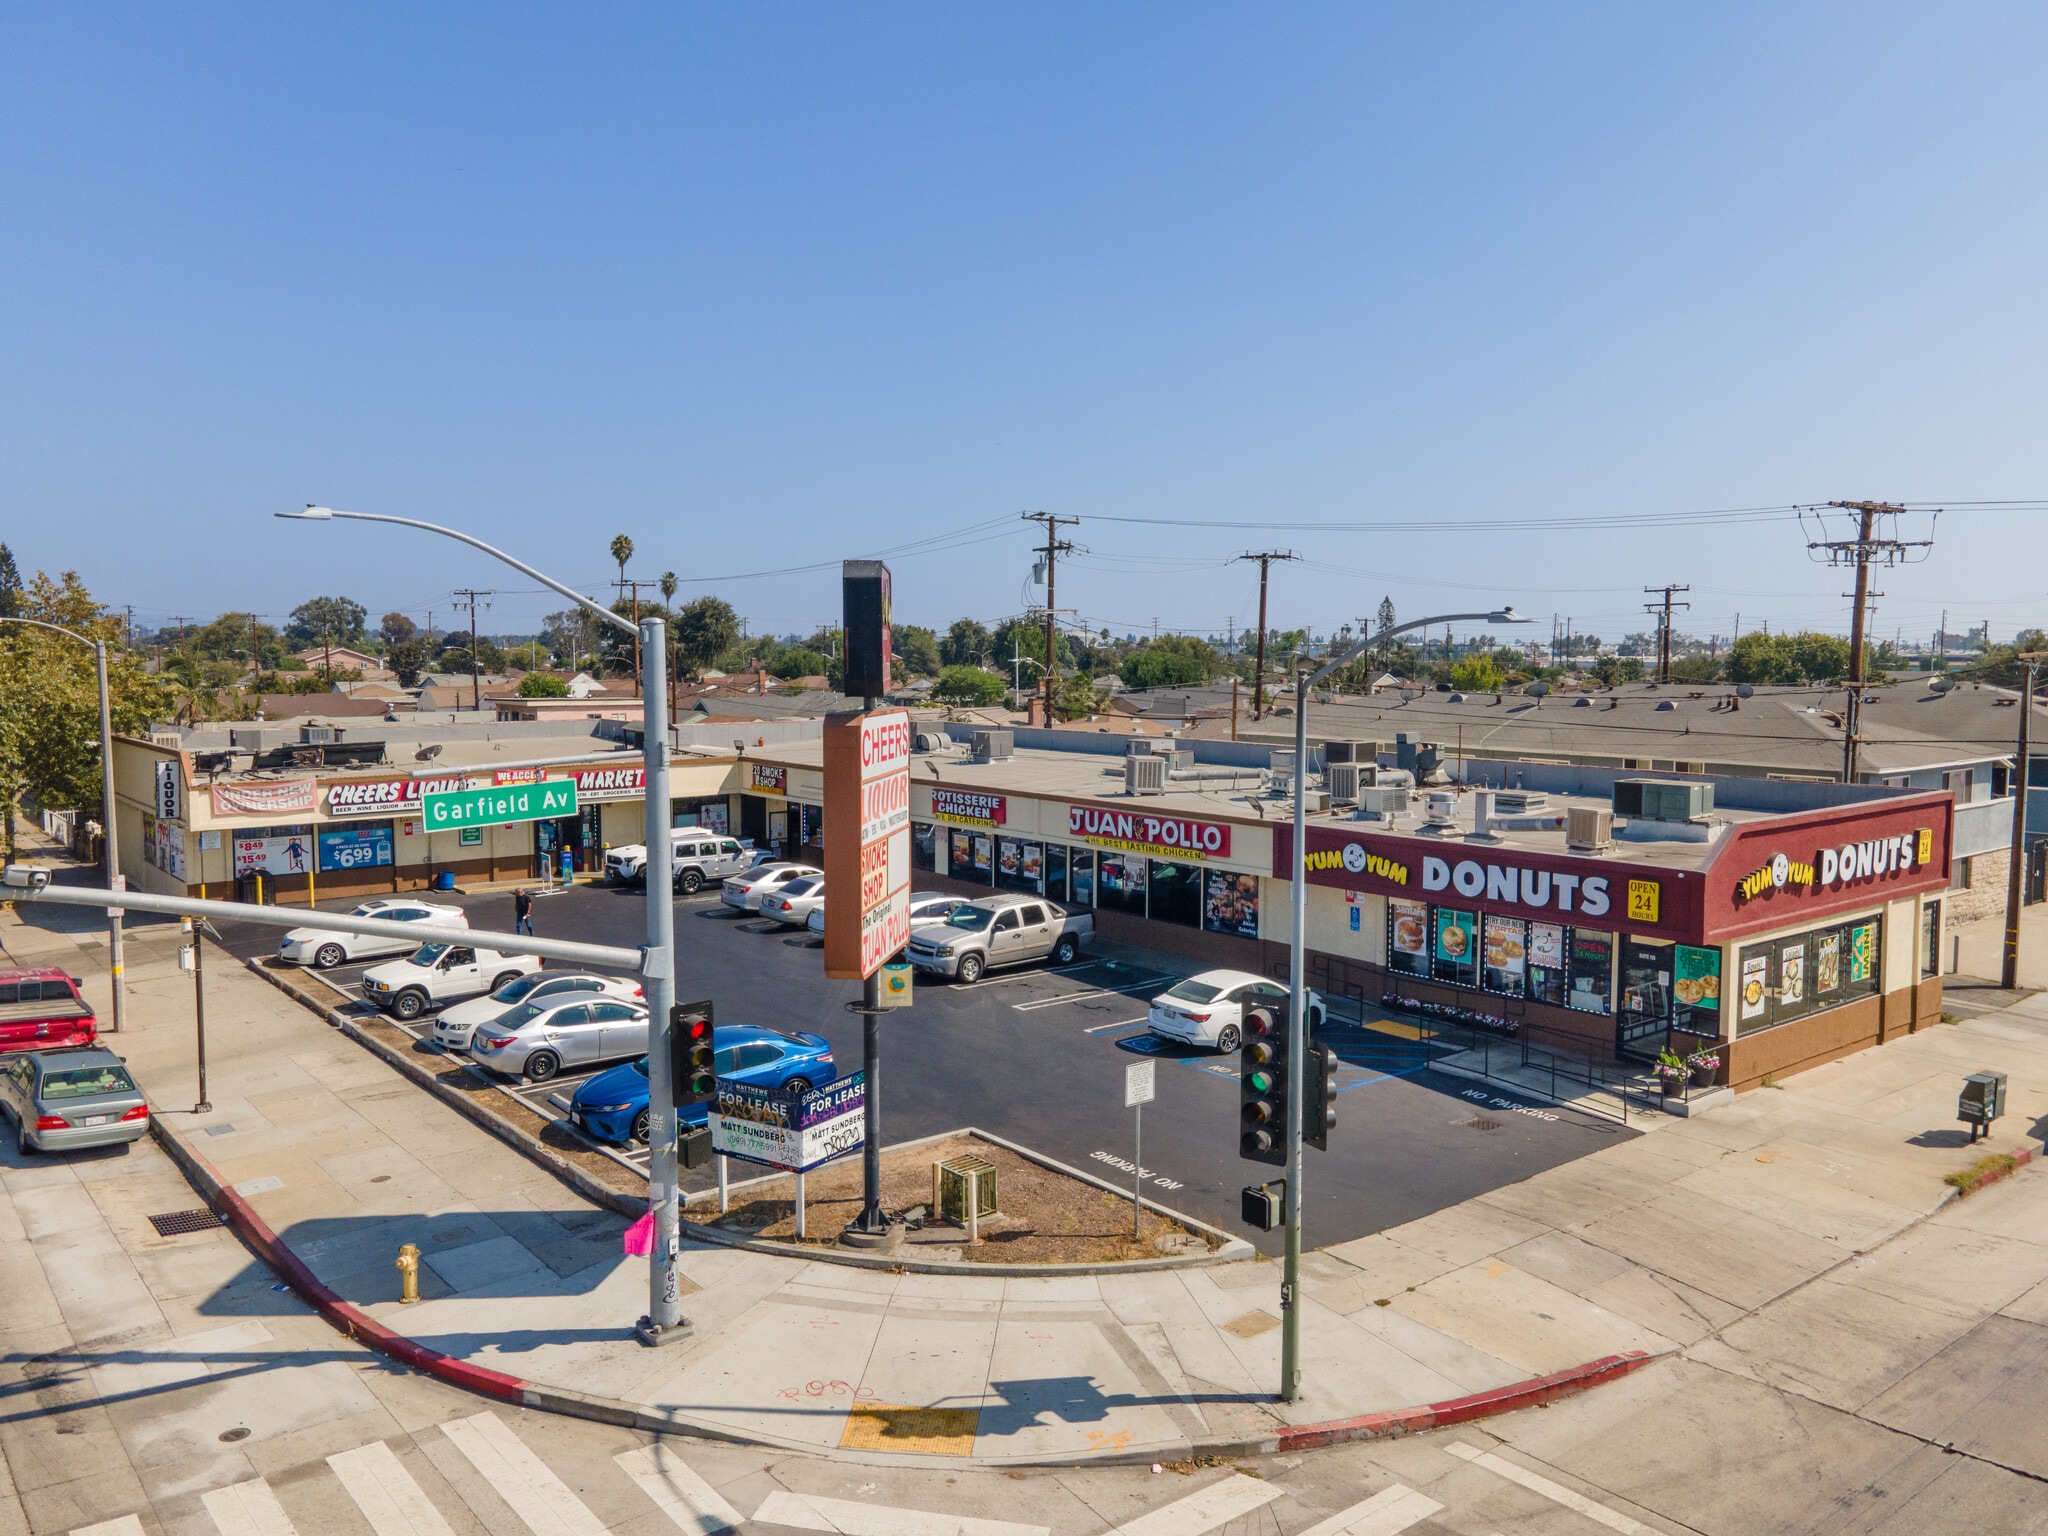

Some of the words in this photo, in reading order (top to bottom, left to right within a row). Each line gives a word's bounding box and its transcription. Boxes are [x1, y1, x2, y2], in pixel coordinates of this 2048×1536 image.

[862, 722, 908, 767] CHEERS
[498, 771, 511, 781] WE
[579, 769, 645, 789] MARKET
[762, 766, 783, 779] SMOKE
[164, 763, 174, 817] LIQUOR
[218, 787, 273, 799] UNDER
[277, 782, 312, 795] NEW
[760, 777, 776, 788] SHOP
[328, 782, 400, 804] CHEERS
[862, 774, 907, 825] LIQUOR
[930, 790, 999, 808] ROTISSERIE
[220, 795, 313, 811] OWNERSHIP
[434, 794, 528, 821] Garfield
[543, 791, 568, 810] Av
[938, 802, 990, 818] CHICKEN
[947, 814, 957, 822] DO
[960, 815, 994, 827] CATERING
[1069, 808, 1133, 838] JUAN
[1143, 818, 1221, 851] POLLO
[1087, 836, 1100, 845] THE
[1103, 838, 1123, 849] BEST
[1126, 842, 1161, 854] TASTING
[1163, 847, 1202, 859] CHICKEN
[1921, 842, 1929, 855] 24
[236, 854, 266, 864] $1549
[334, 848, 372, 867] $699
[862, 841, 887, 877] SMOKE
[1743, 866, 1772, 899] YUM
[1788, 862, 1814, 886] YUM
[1822, 834, 1913, 885] DONUTS
[864, 872, 883, 908] SHOP
[1305, 850, 1343, 871] YUM
[1366, 854, 1408, 885] YUM
[1423, 856, 1610, 916] DONUTS
[1630, 881, 1657, 894] OPEN
[1633, 894, 1652, 911] 24
[862, 916, 872, 930] The
[872, 898, 892, 923] Original
[1489, 916, 1498, 924] TRY
[1499, 918, 1511, 927] OUR
[1511, 920, 1523, 929] NEW
[1632, 911, 1655, 920] HOURS
[1489, 924, 1524, 935] TORTAS
[862, 923, 886, 973] JUAN
[888, 905, 909, 947] POLLO
[1574, 941, 1605, 953] OPEN
[1574, 949, 1583, 957] 24
[736, 1084, 768, 1095] MATTHEWS
[825, 1077, 853, 1095] MATTHEWS
[719, 1091, 742, 1104] FOR
[748, 1098, 787, 1116] LEASE
[810, 1100, 832, 1115] FOR
[835, 1083, 865, 1104] LEASE
[1461, 1089, 1487, 1100] NO
[1489, 1097, 1559, 1121] PARKING
[720, 1121, 740, 1133] MATT
[743, 1125, 785, 1143] SUNDBERG
[812, 1127, 829, 1142] MATT
[831, 1112, 865, 1131] SUNDBERG
[761, 1141, 777, 1151] 5991
[1089, 1151, 1156, 1179] PARKING
[1154, 1177, 1184, 1190] NO
